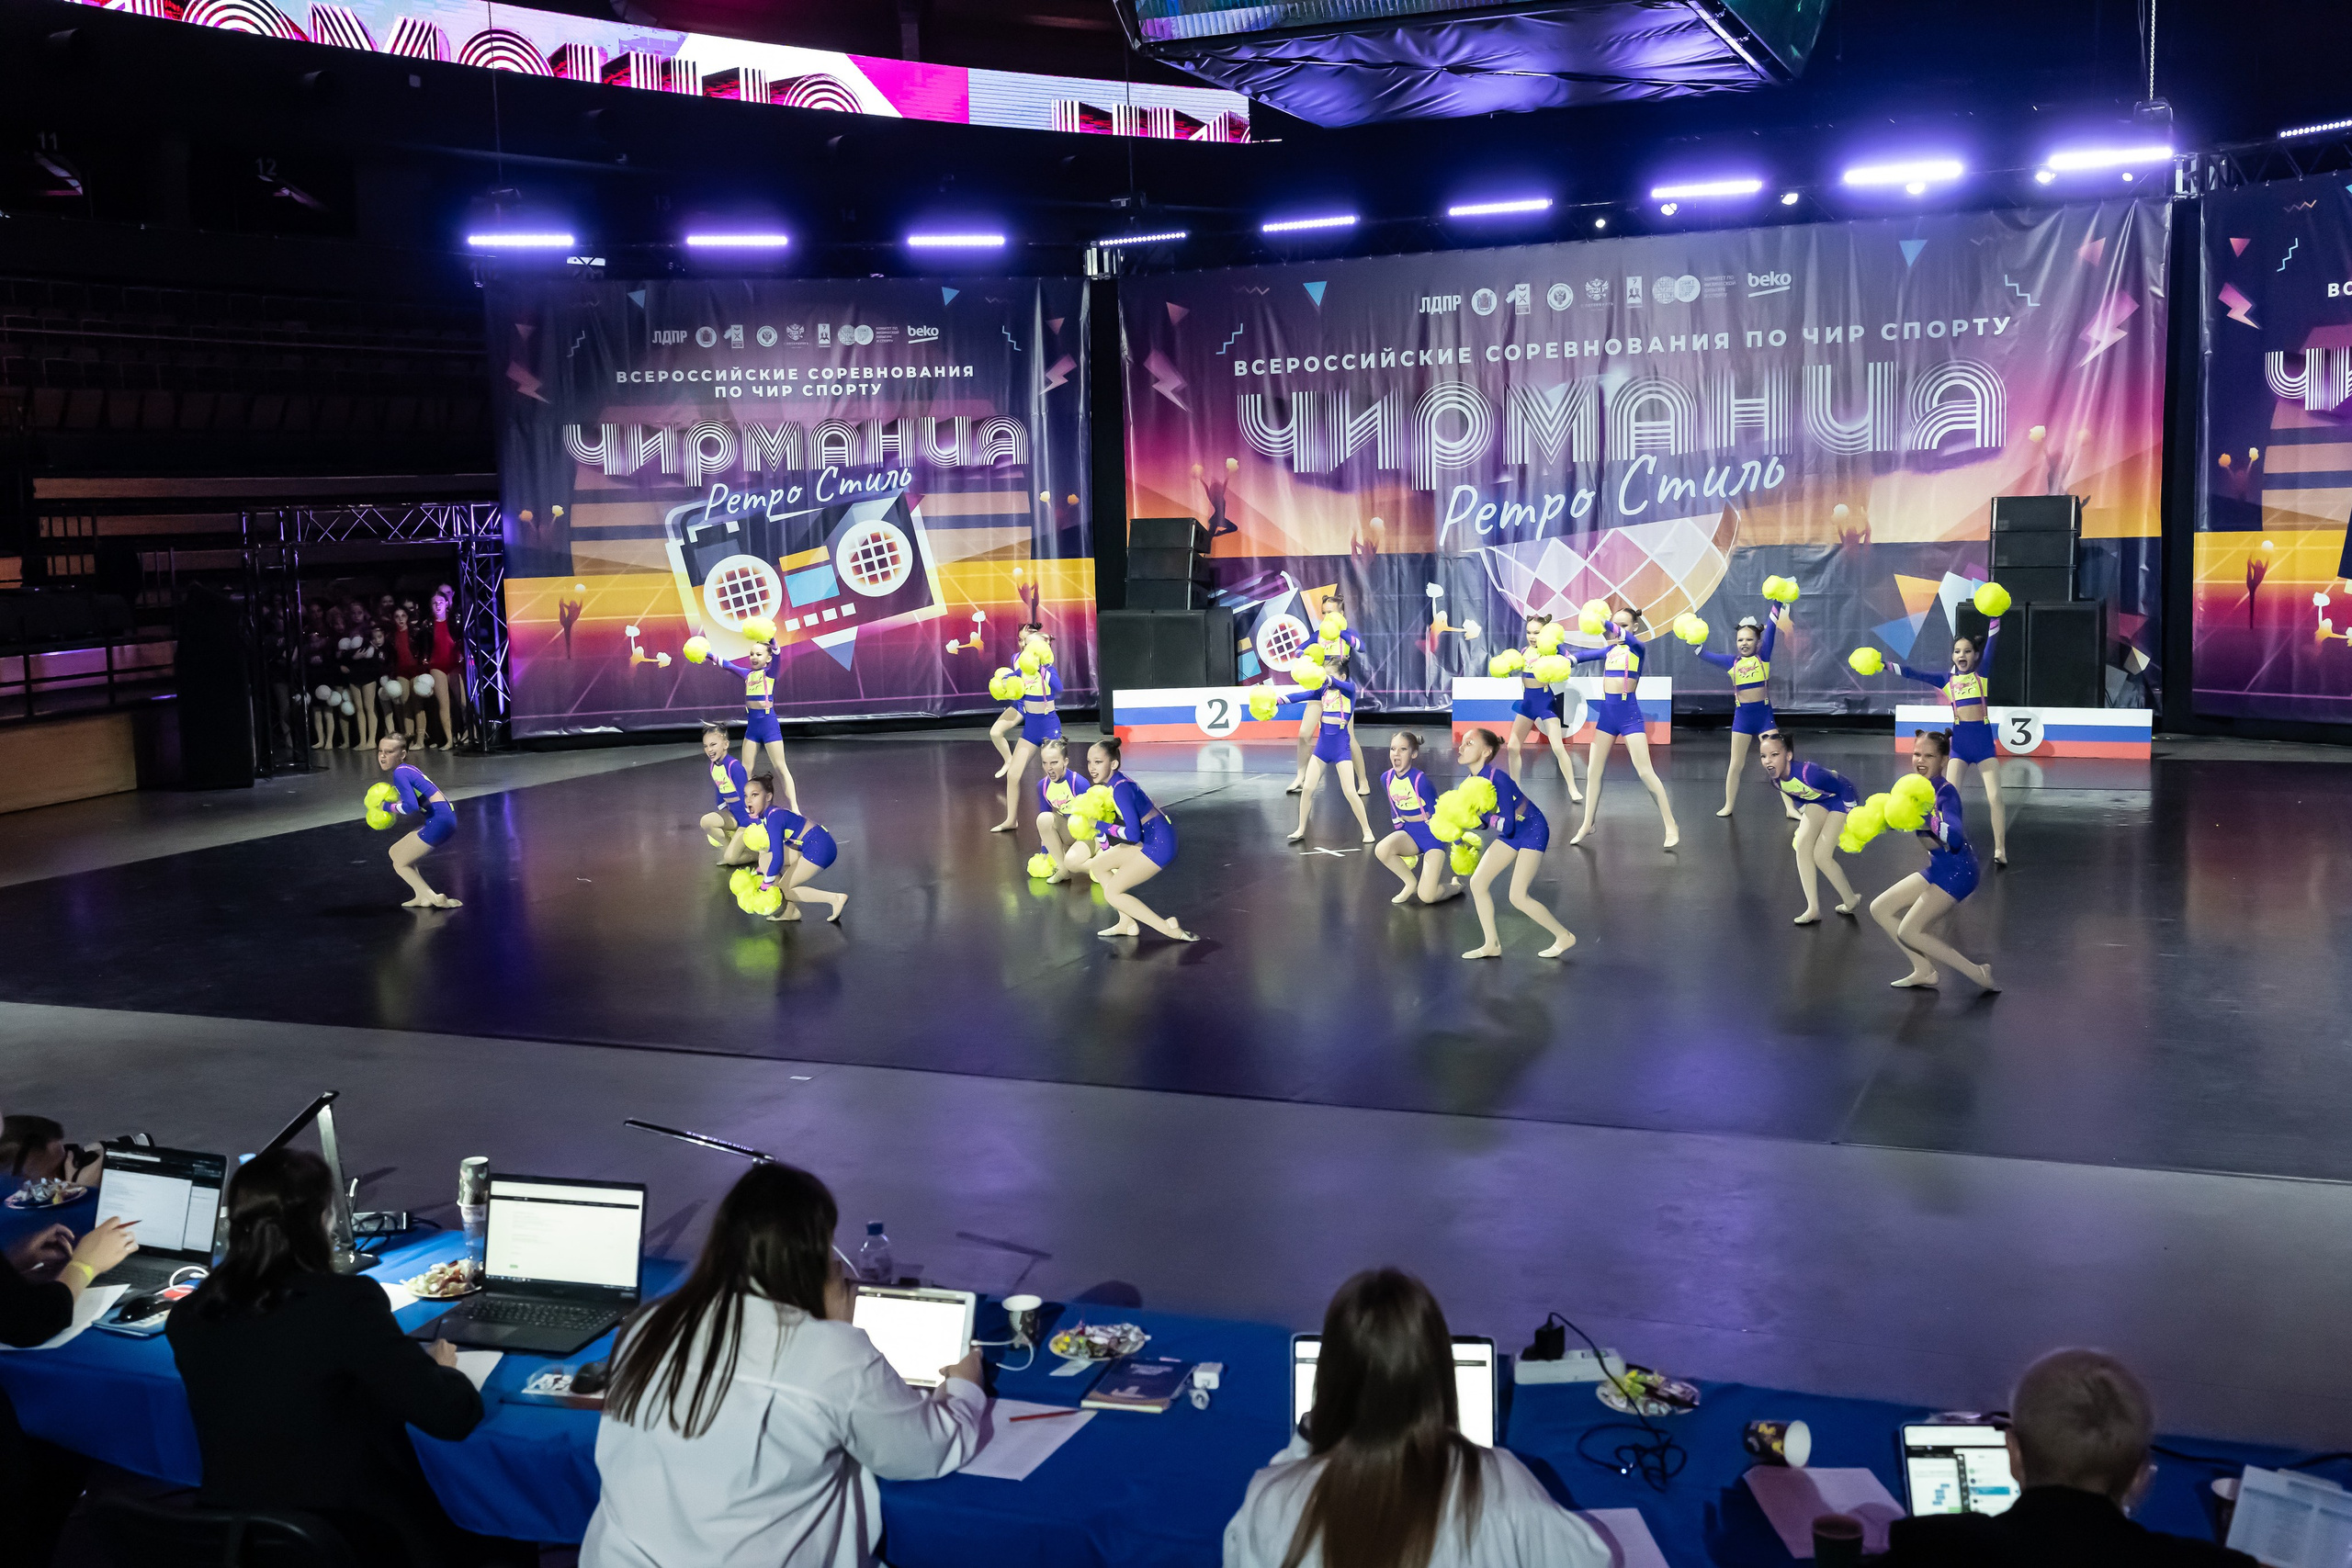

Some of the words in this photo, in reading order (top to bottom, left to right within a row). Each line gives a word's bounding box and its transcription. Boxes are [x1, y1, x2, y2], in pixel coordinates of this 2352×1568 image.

[36, 131, 58, 151] 11
[254, 158, 277, 176] 12
[1747, 271, 1792, 287] beko
[1419, 295, 1462, 315] ЛДПР
[651, 330, 688, 345] ЛДПР
[907, 325, 939, 337] beko
[1233, 347, 1472, 377] ВСЕРОССИЙСКИЕ
[1486, 336, 1730, 362] СОРЕВНОВАНИЯ
[1747, 330, 1787, 348] ПО
[1803, 323, 1864, 344] ЧИР
[1881, 315, 2013, 341] СПОРТУ
[616, 367, 799, 383] ВСЕРОССИЙСКИЕ
[808, 366, 975, 380] СОРЕВНОВАНИЯ
[715, 386, 742, 398] ПО
[752, 384, 793, 398] ЧИР
[803, 382, 882, 398] СПОРТУ
[1237, 359, 2008, 491] ЧИРМАНЦА
[562, 416, 1030, 487] ЧИРМАНЦА
[705, 484, 802, 522] Ретро
[816, 465, 913, 502] Стиль
[1439, 485, 1592, 547] Ретро
[1618, 452, 1787, 516] Стиль
[1207, 698, 1229, 729] 2
[2010, 717, 2032, 746] 3
